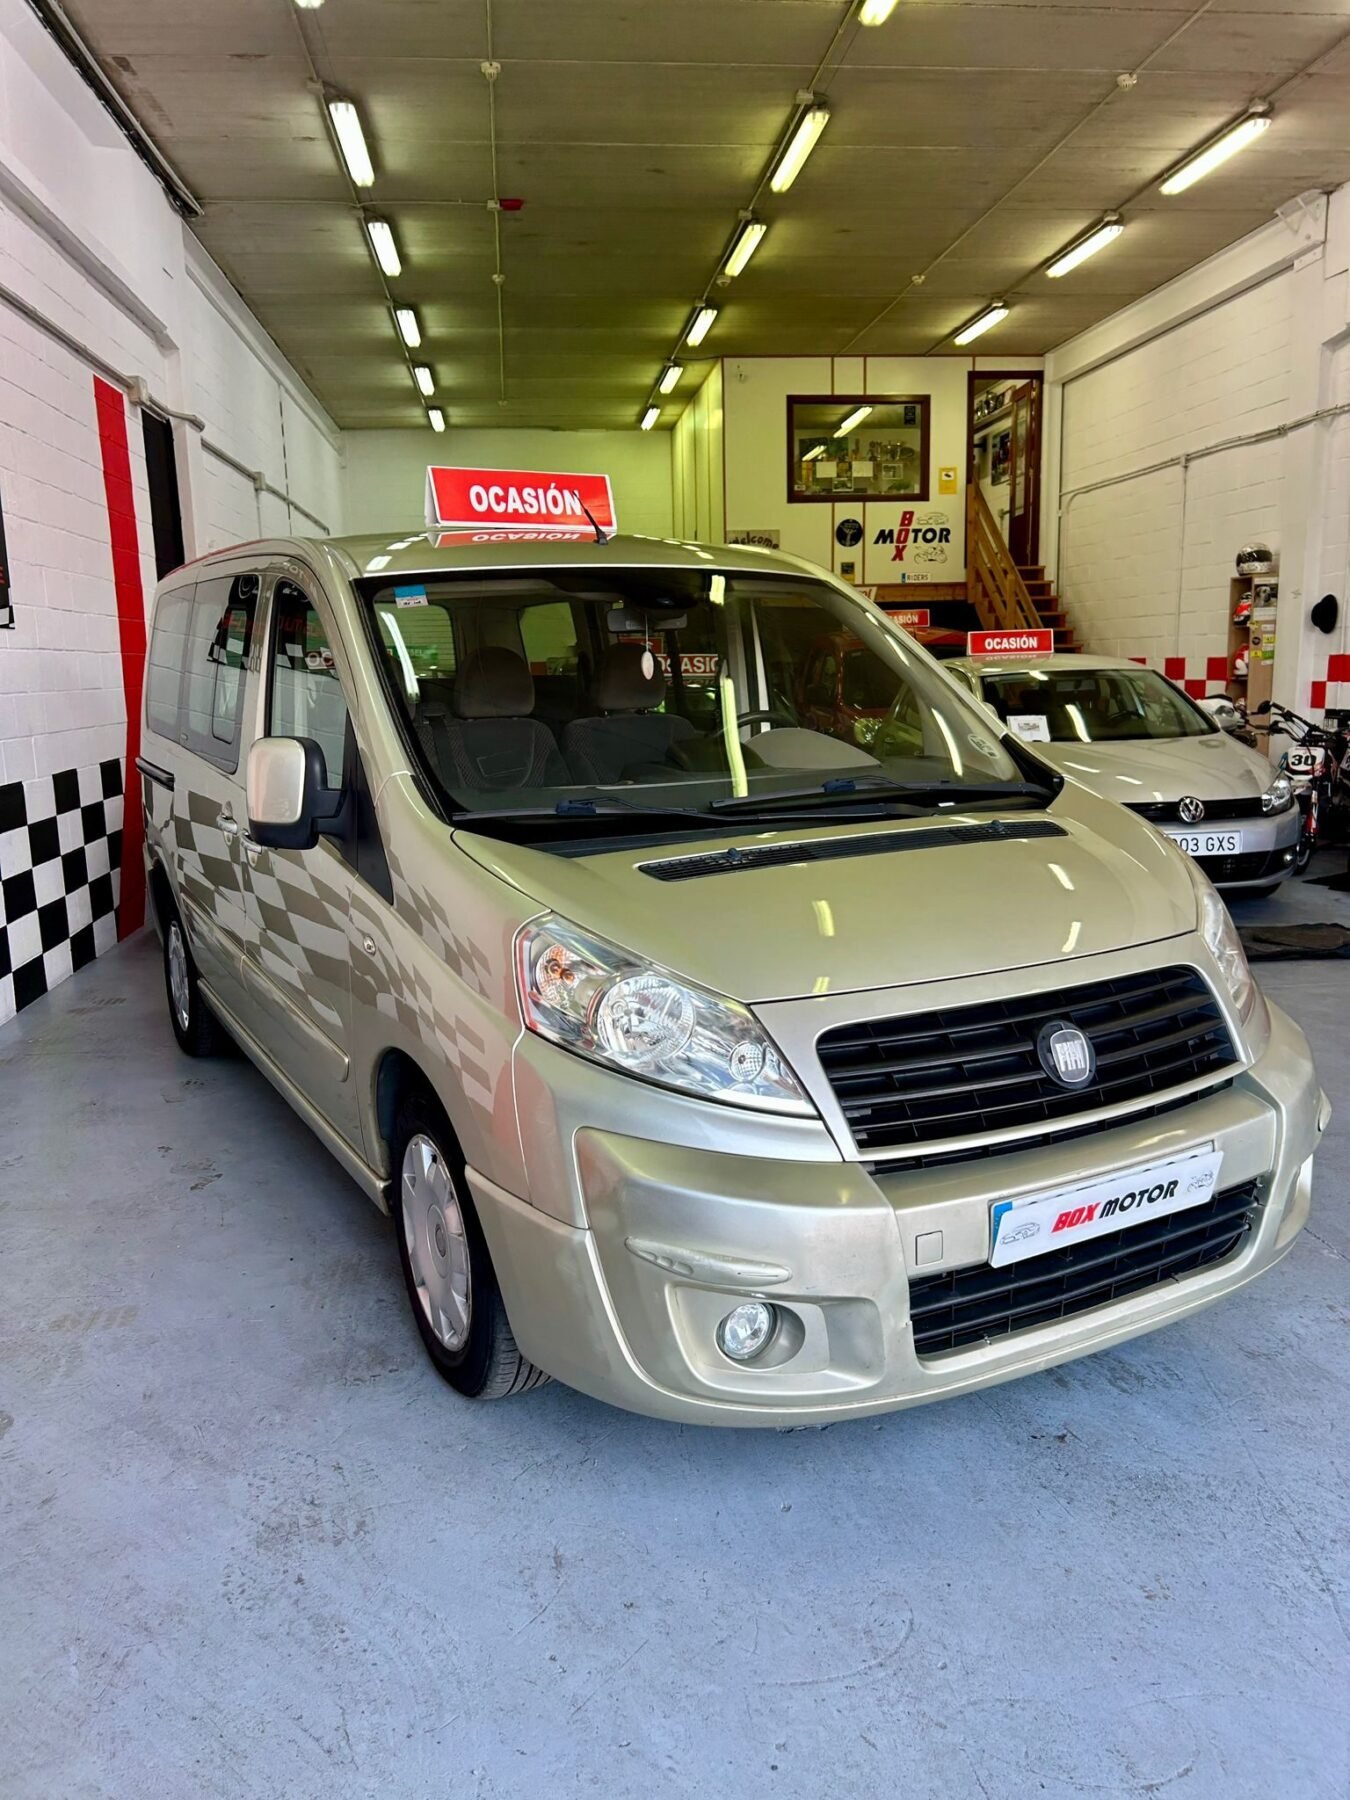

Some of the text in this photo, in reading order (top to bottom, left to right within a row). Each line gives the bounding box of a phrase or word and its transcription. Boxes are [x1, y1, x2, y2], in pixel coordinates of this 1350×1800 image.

[469, 483, 582, 516] OCASIÓN
[984, 635, 1038, 650] OCASIÓN
[1291, 754, 1317, 766] 30
[1205, 836, 1236, 852] GXS
[1051, 1179, 1179, 1233] BOX MOTOR
